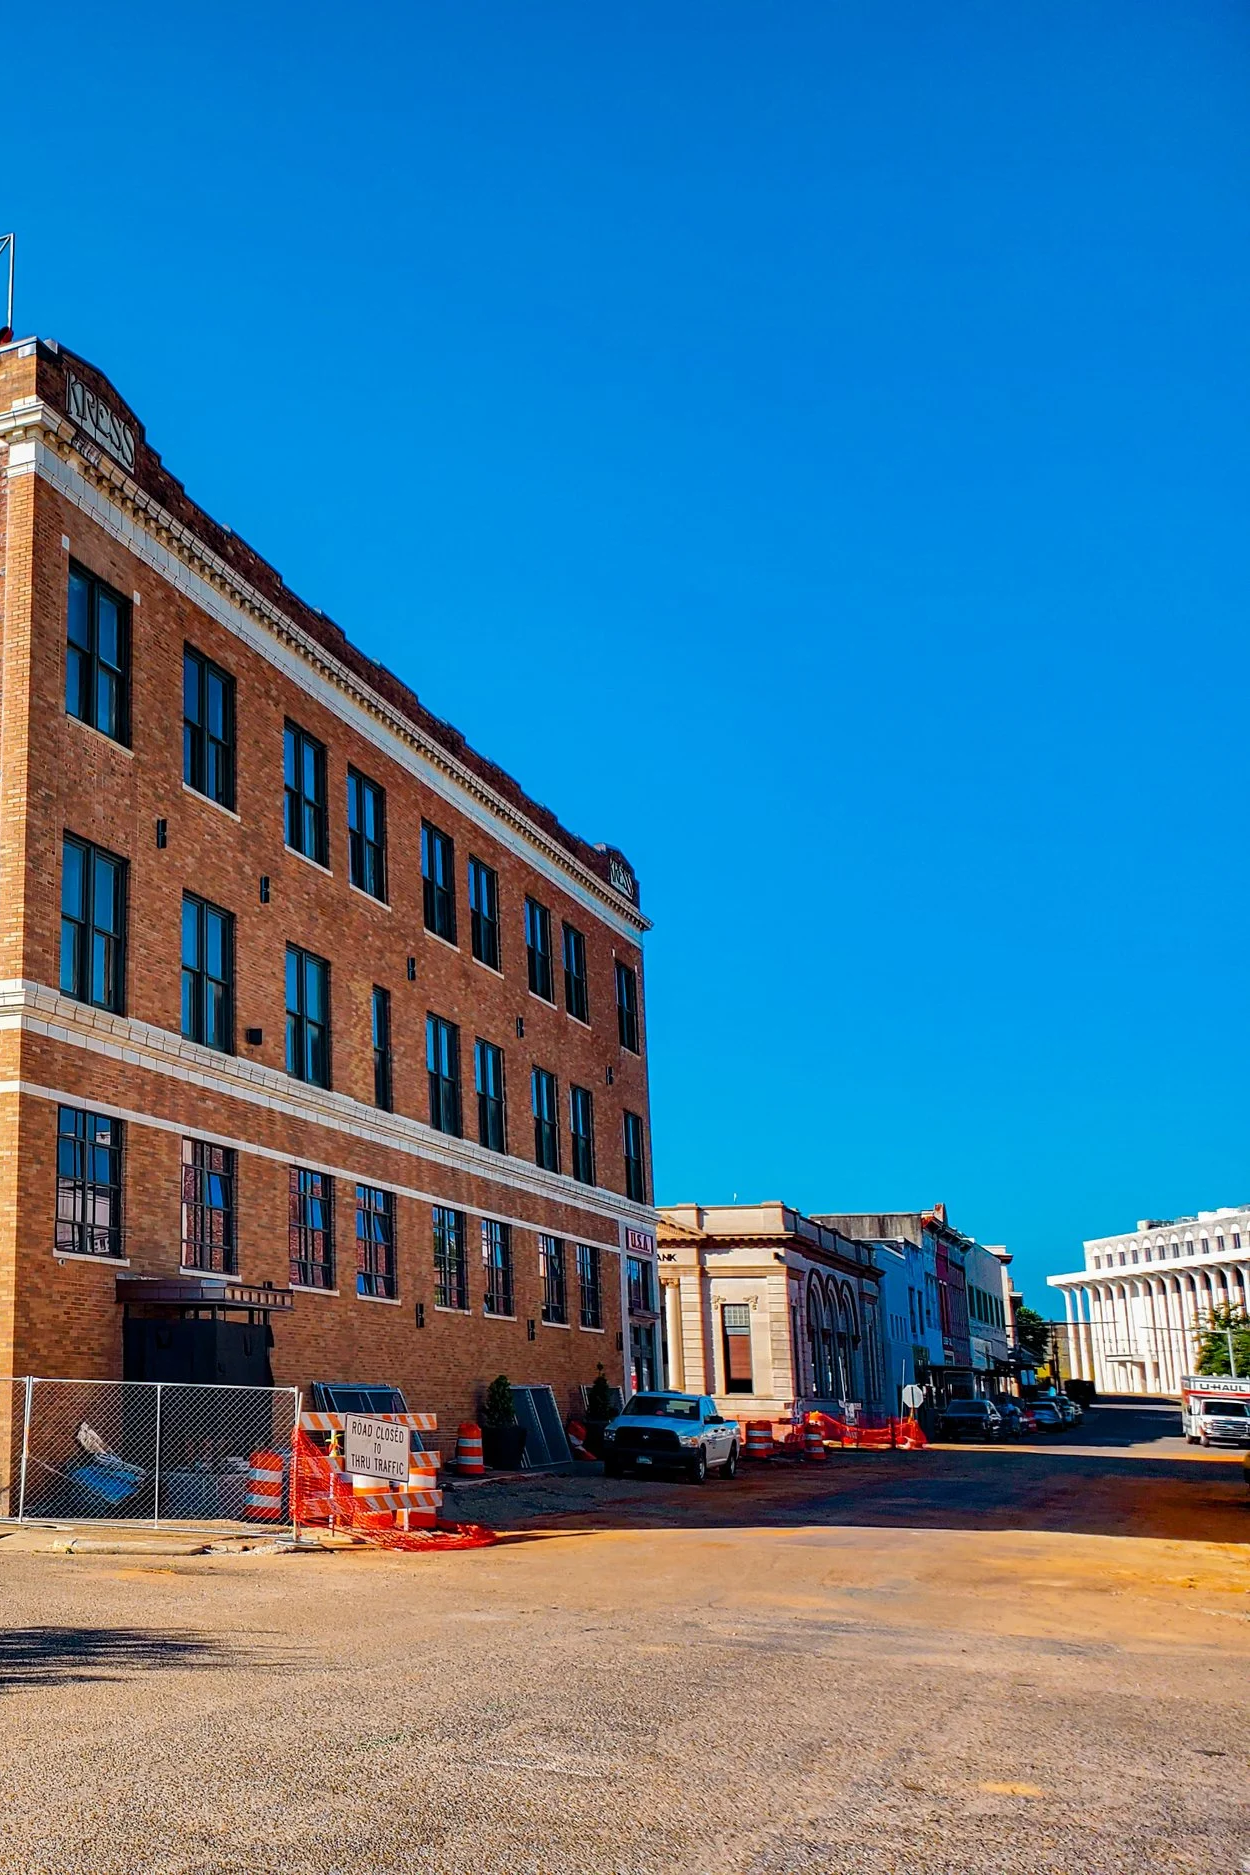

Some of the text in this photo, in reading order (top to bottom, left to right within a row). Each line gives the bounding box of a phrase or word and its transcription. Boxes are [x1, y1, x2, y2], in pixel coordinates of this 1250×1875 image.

[65, 369, 134, 468] KRESS
[657, 1254, 677, 1262] ANK
[352, 1421, 404, 1443] ROAD CLOSED
[374, 1443, 382, 1454] TO
[351, 1454, 404, 1475] THRU TRAFFIC
